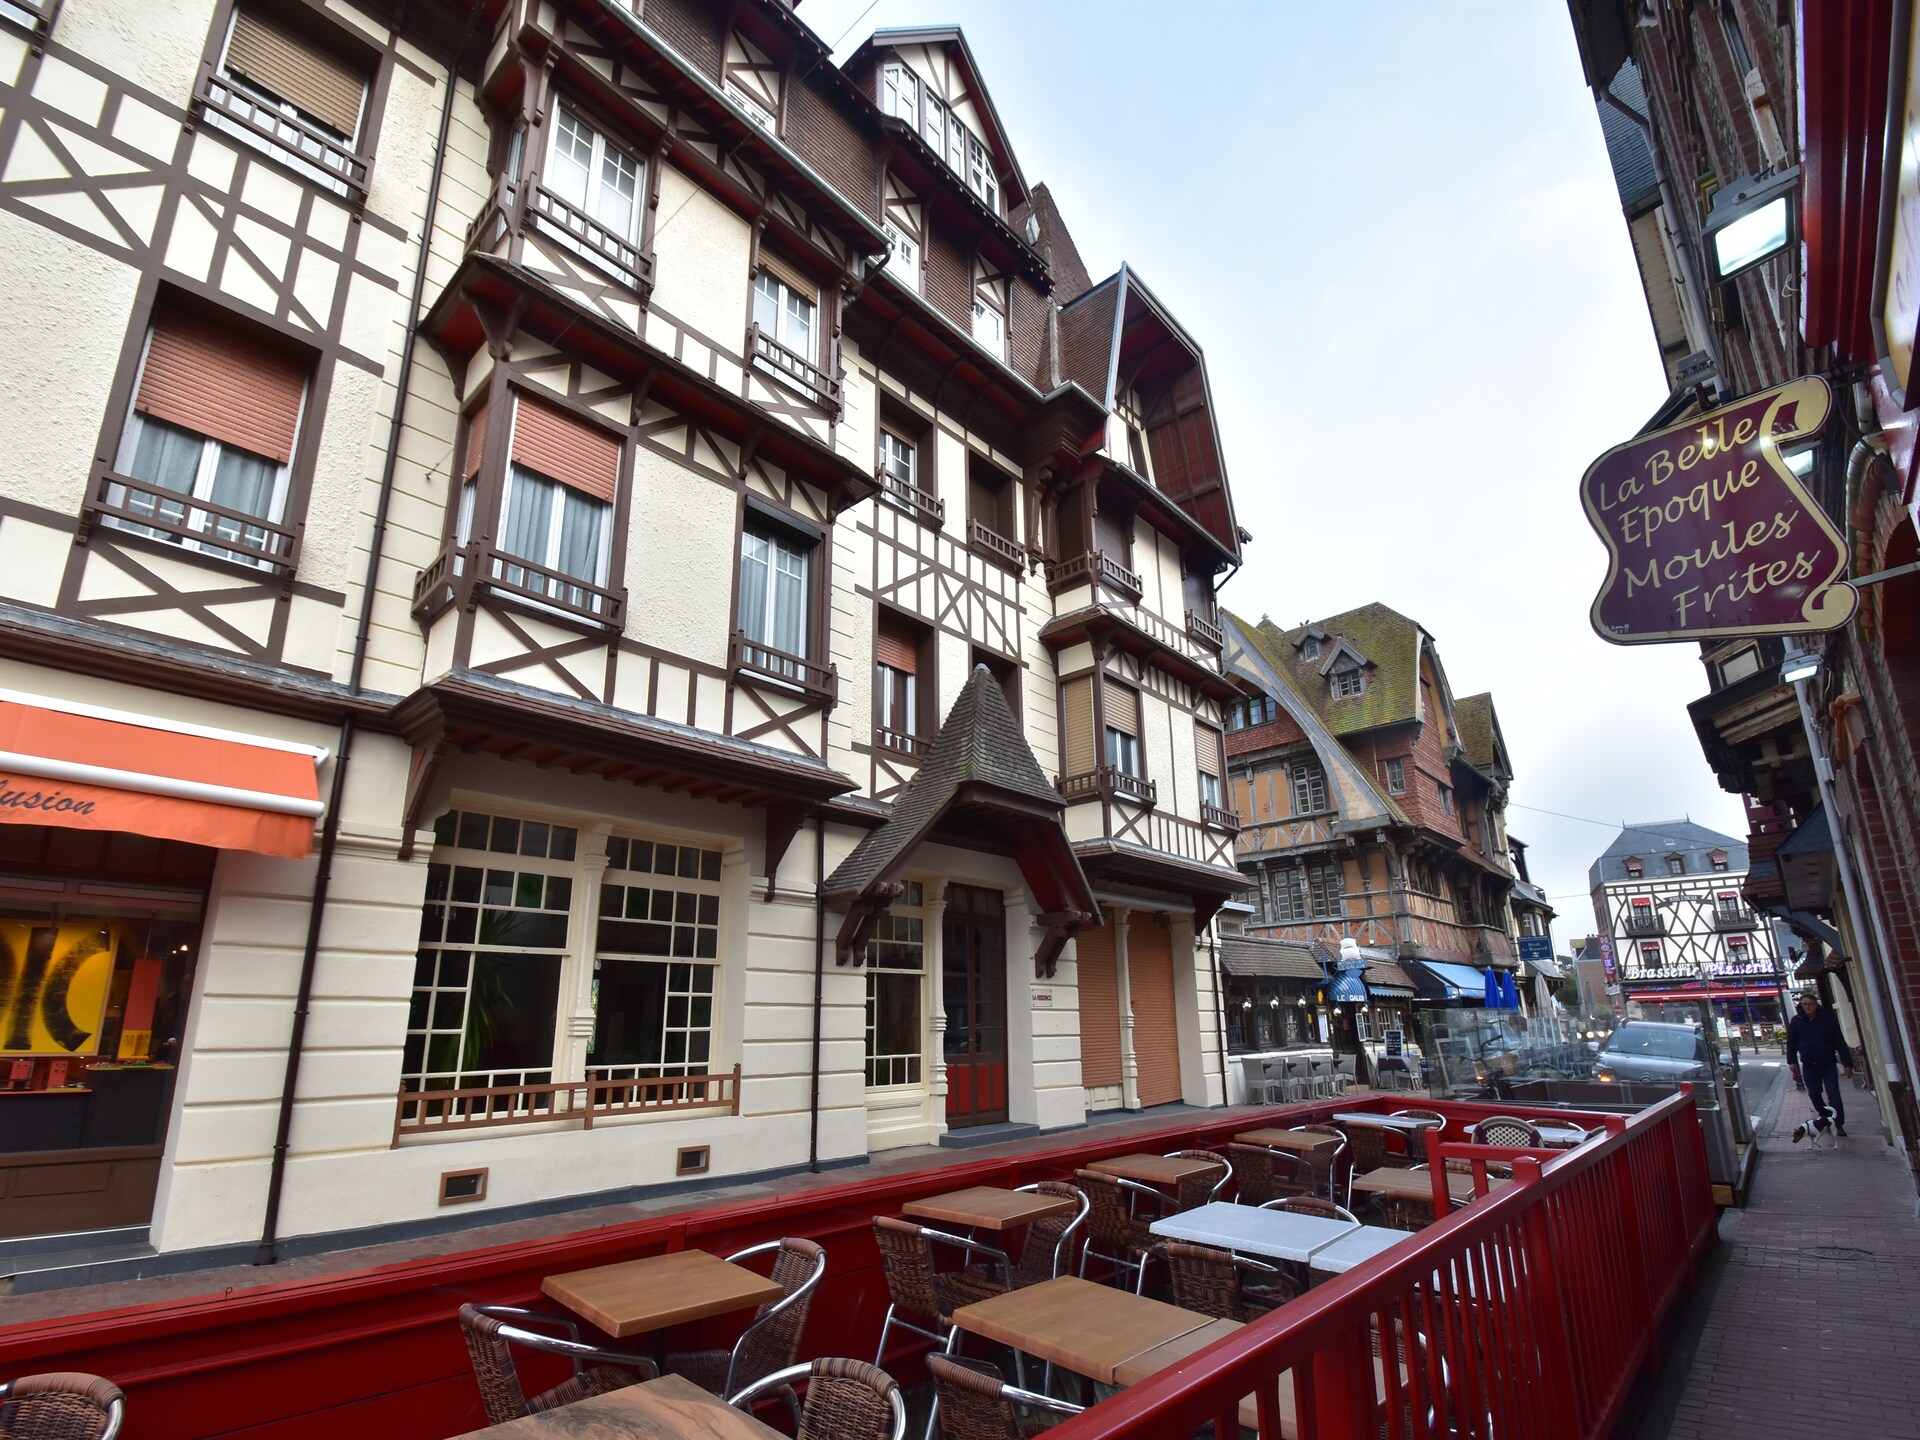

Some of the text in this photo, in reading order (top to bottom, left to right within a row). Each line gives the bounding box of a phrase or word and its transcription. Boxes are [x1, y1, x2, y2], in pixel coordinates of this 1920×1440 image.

[1600, 416, 1758, 512] La Belle
[1618, 459, 1761, 548] Epoque
[1623, 510, 1799, 598] Moules
[1672, 550, 1821, 628] Frites
